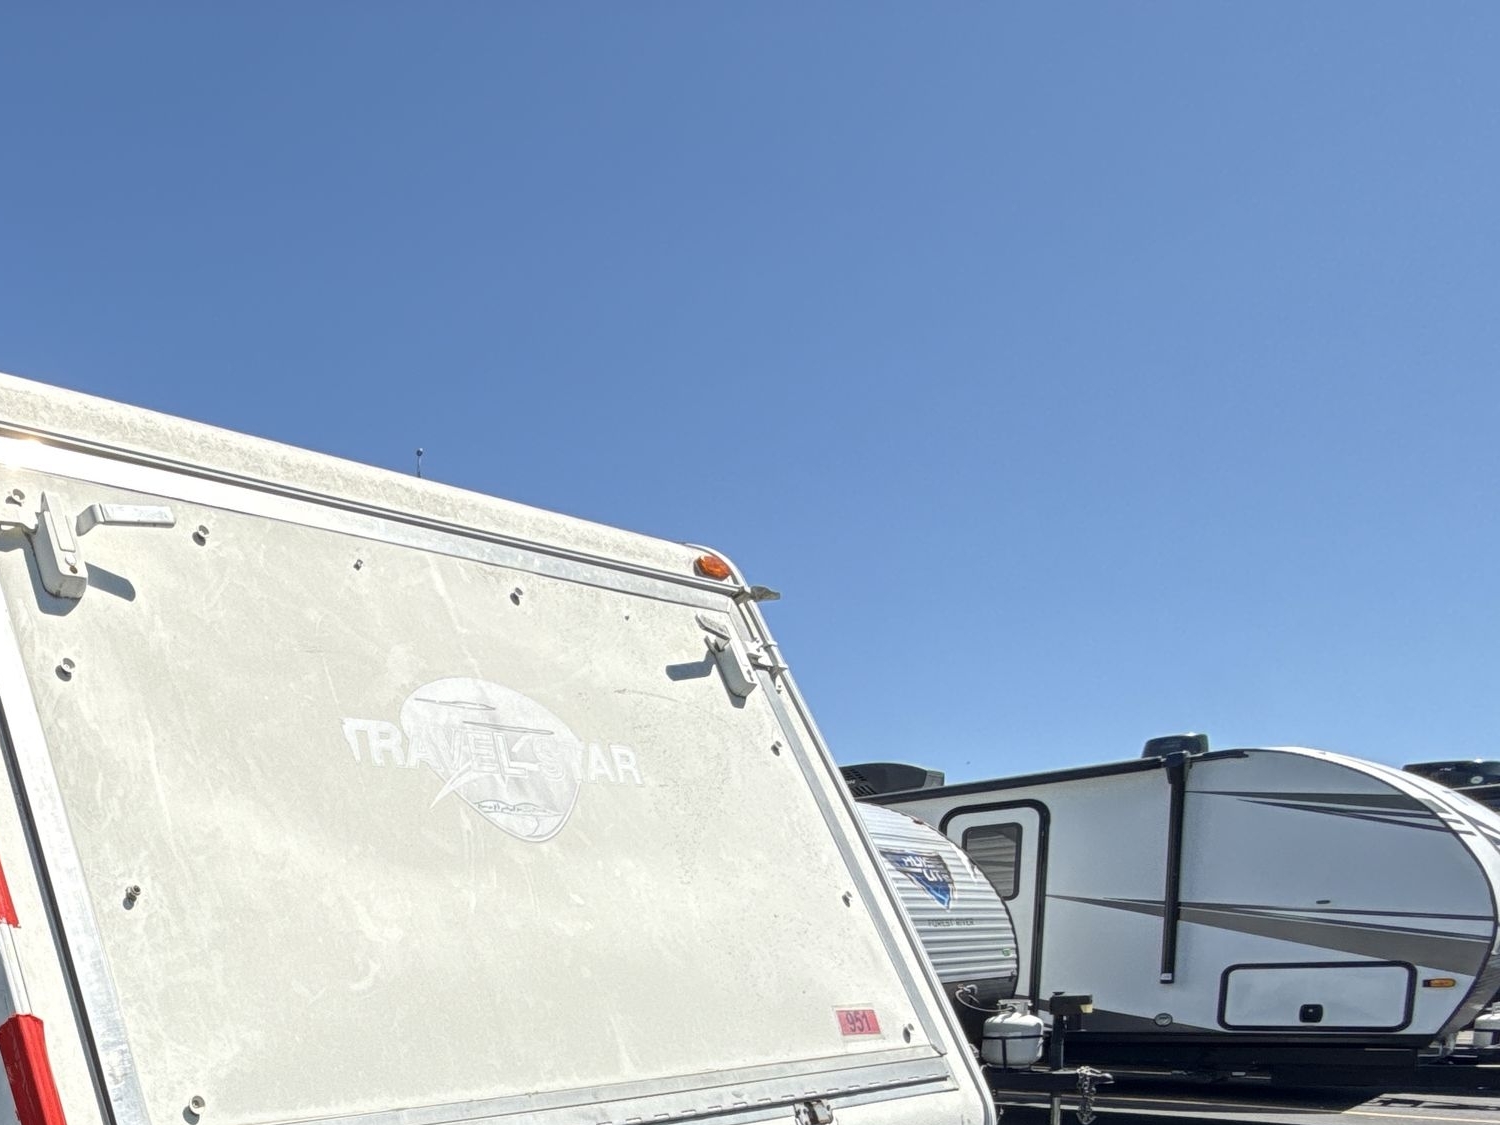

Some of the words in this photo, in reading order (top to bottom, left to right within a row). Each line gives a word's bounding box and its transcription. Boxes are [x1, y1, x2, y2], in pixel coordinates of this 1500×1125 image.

[340, 718, 529, 777] TRAVEL
[531, 735, 644, 785] STAR
[845, 1011, 871, 1033] 951
